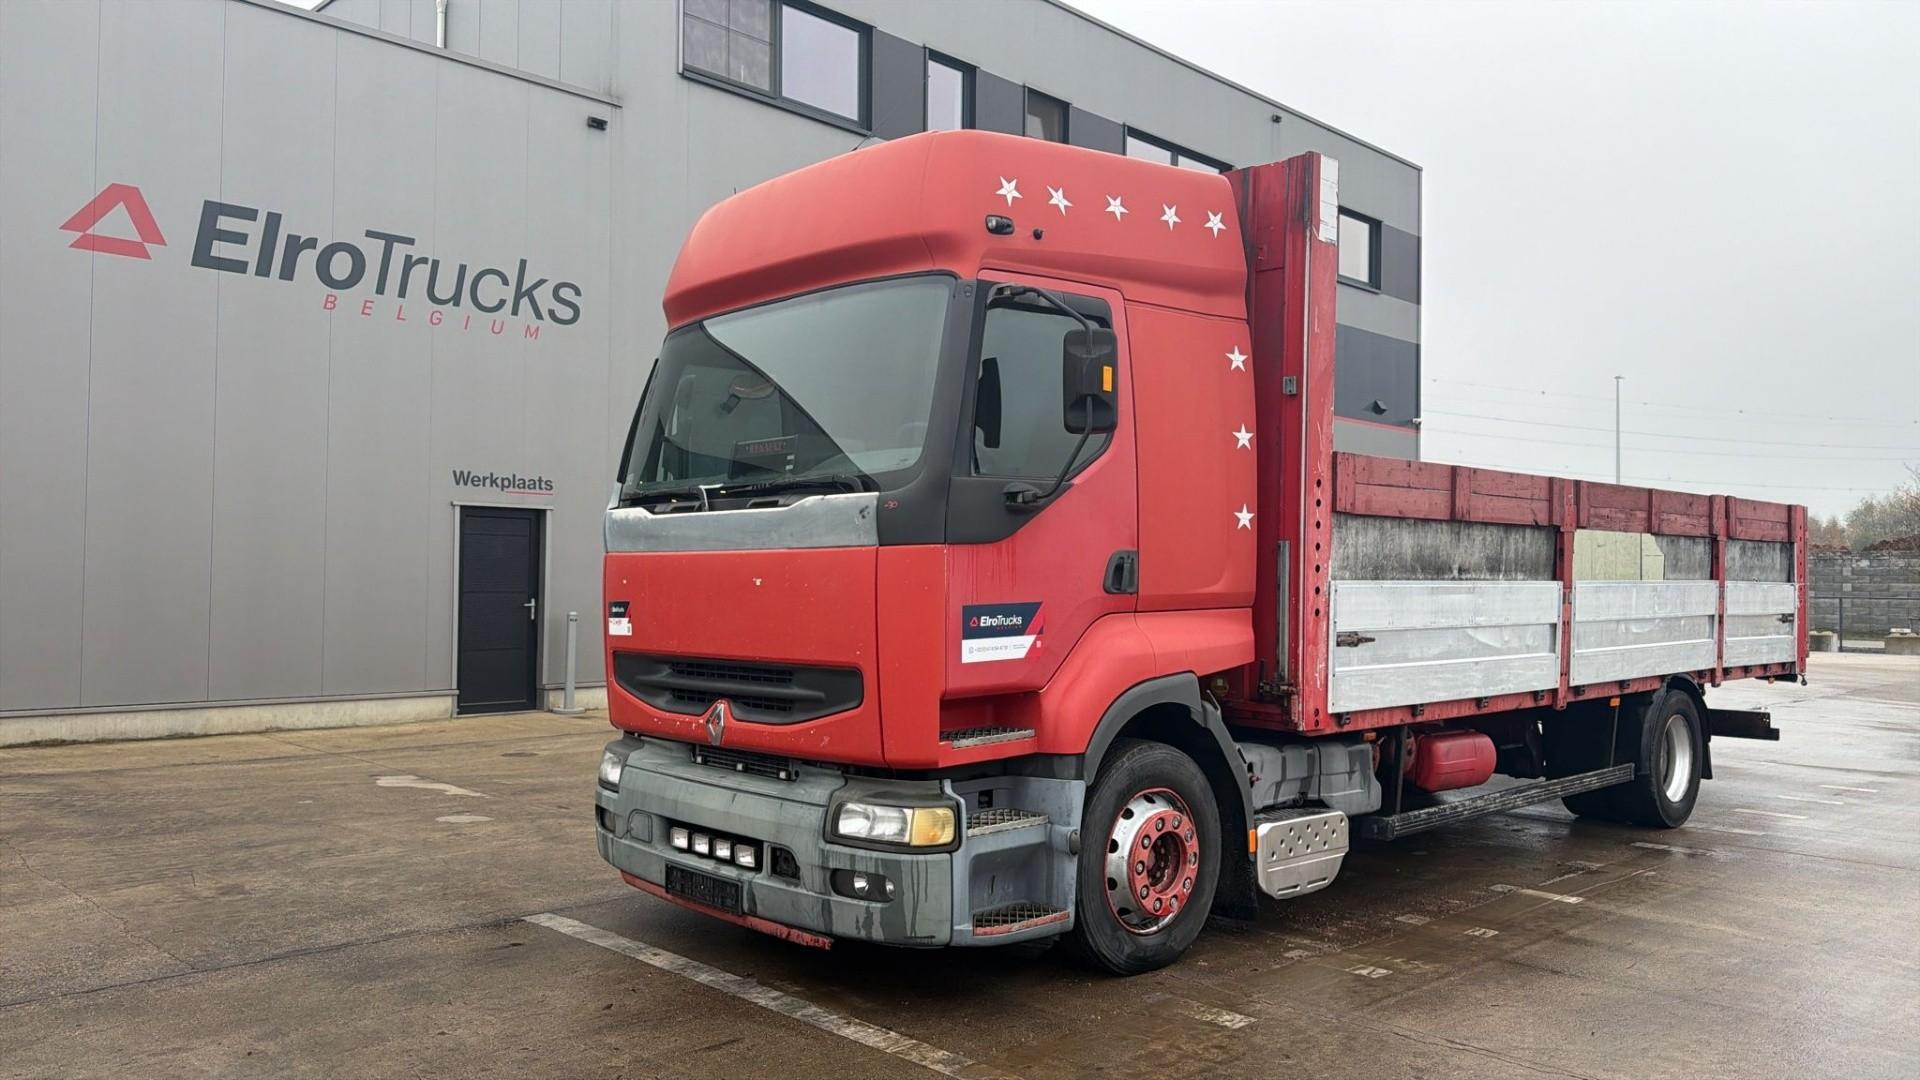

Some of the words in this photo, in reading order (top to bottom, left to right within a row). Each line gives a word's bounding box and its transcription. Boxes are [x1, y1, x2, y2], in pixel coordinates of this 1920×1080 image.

[191, 200, 582, 326] ElroTrucks
[323, 294, 540, 340] BELGIUM
[452, 470, 553, 491] Werkplaats
[980, 614, 1023, 627] ElroTrucks
